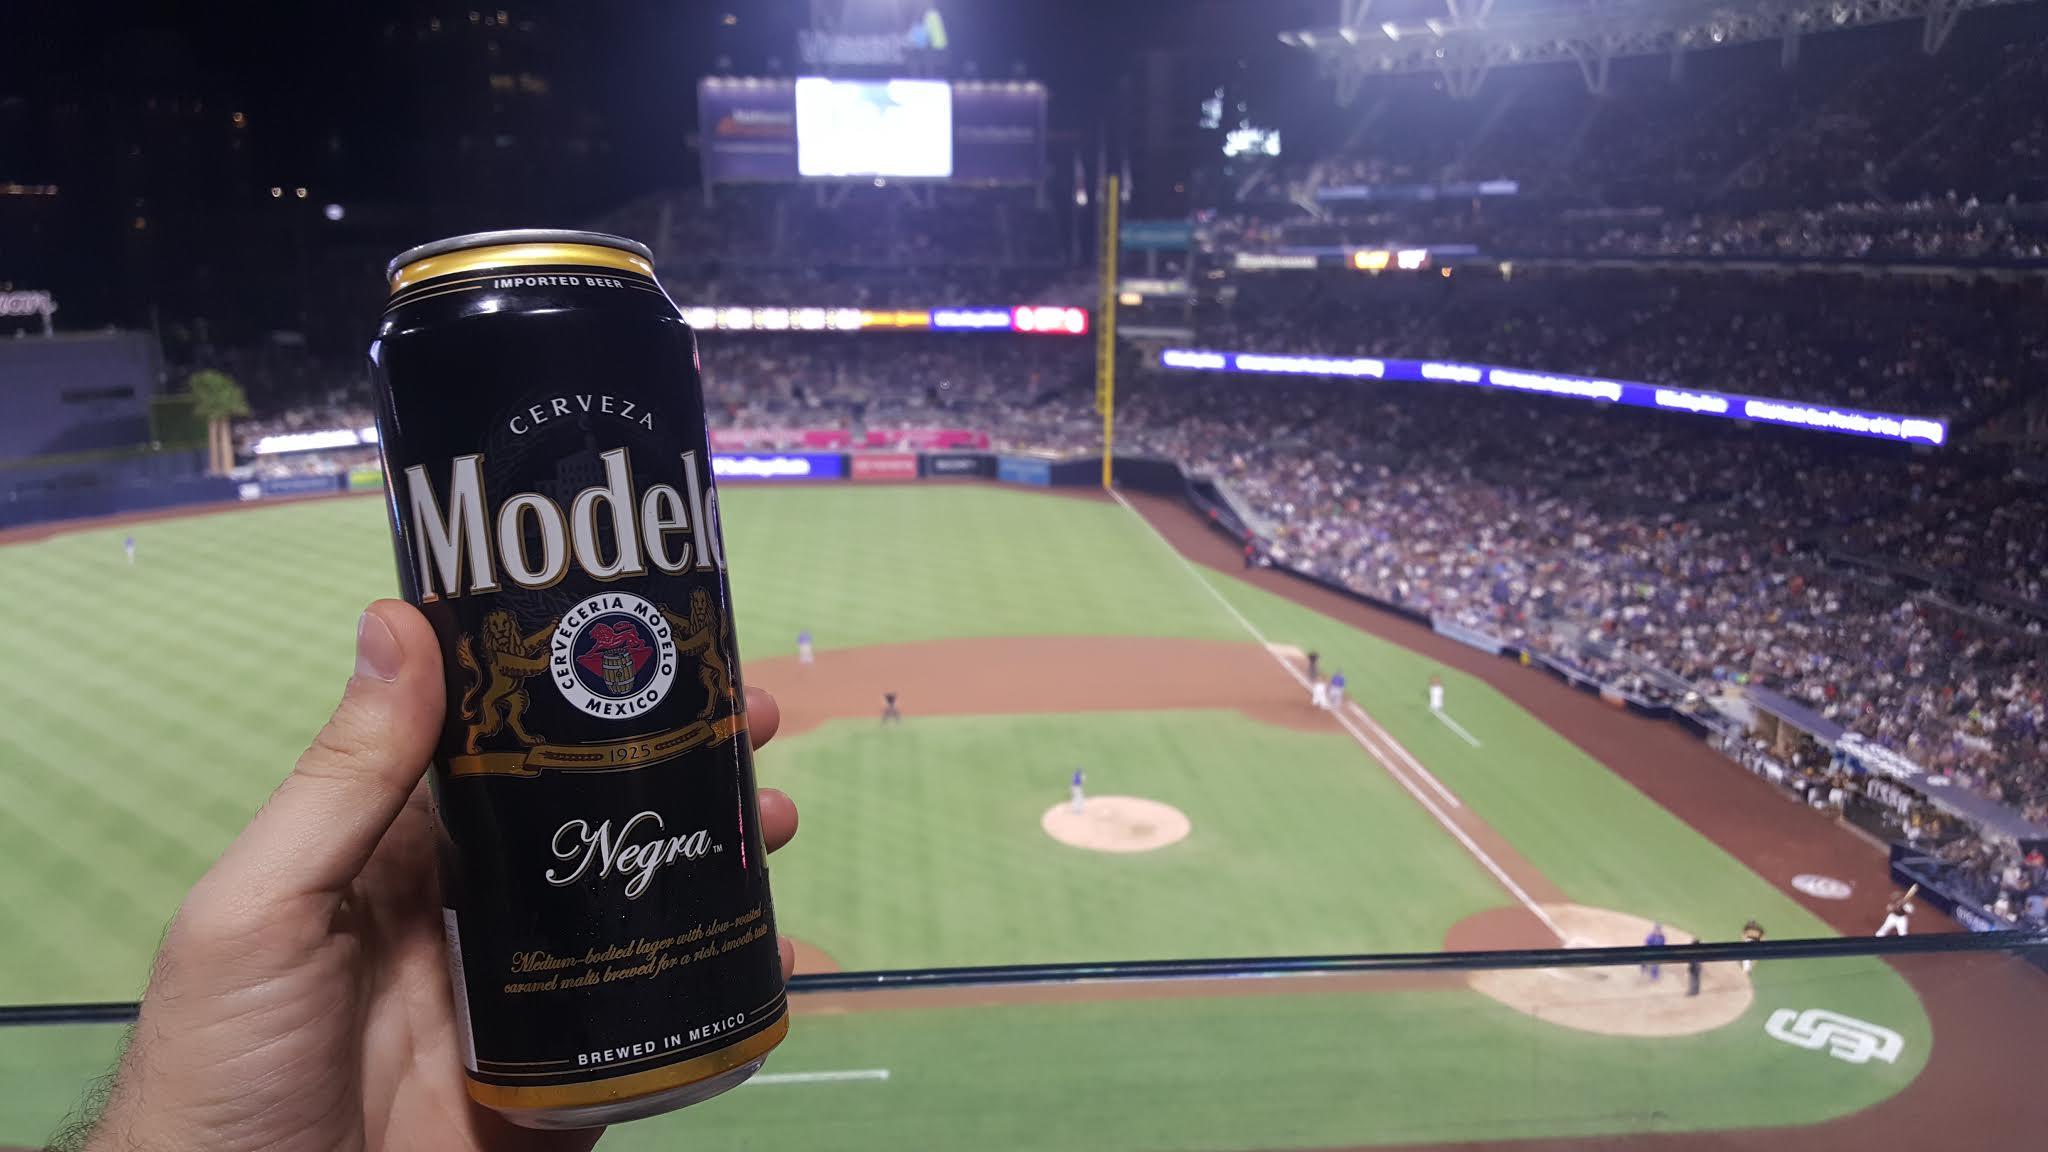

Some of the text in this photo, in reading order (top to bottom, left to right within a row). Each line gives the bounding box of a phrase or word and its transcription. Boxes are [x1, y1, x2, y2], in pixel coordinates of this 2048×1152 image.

[494, 276, 624, 289] IMPORTED BEER
[509, 394, 654, 435] CERVEZA
[554, 597, 673, 690] CERVECERIA MODELO
[585, 689, 659, 716] MEXICO
[610, 744, 651, 763] 1925
[545, 811, 712, 900] Negra
[504, 974, 558, 993] caramel
[560, 968, 600, 989] malts
[603, 956, 657, 982] brewed
[649, 952, 679, 979] for
[694, 940, 720, 962] rich,
[511, 940, 635, 973] Medium-bodied
[636, 936, 675, 961] lager
[676, 923, 704, 946] with
[578, 1012, 746, 1066] BREWED IN MEXICO
